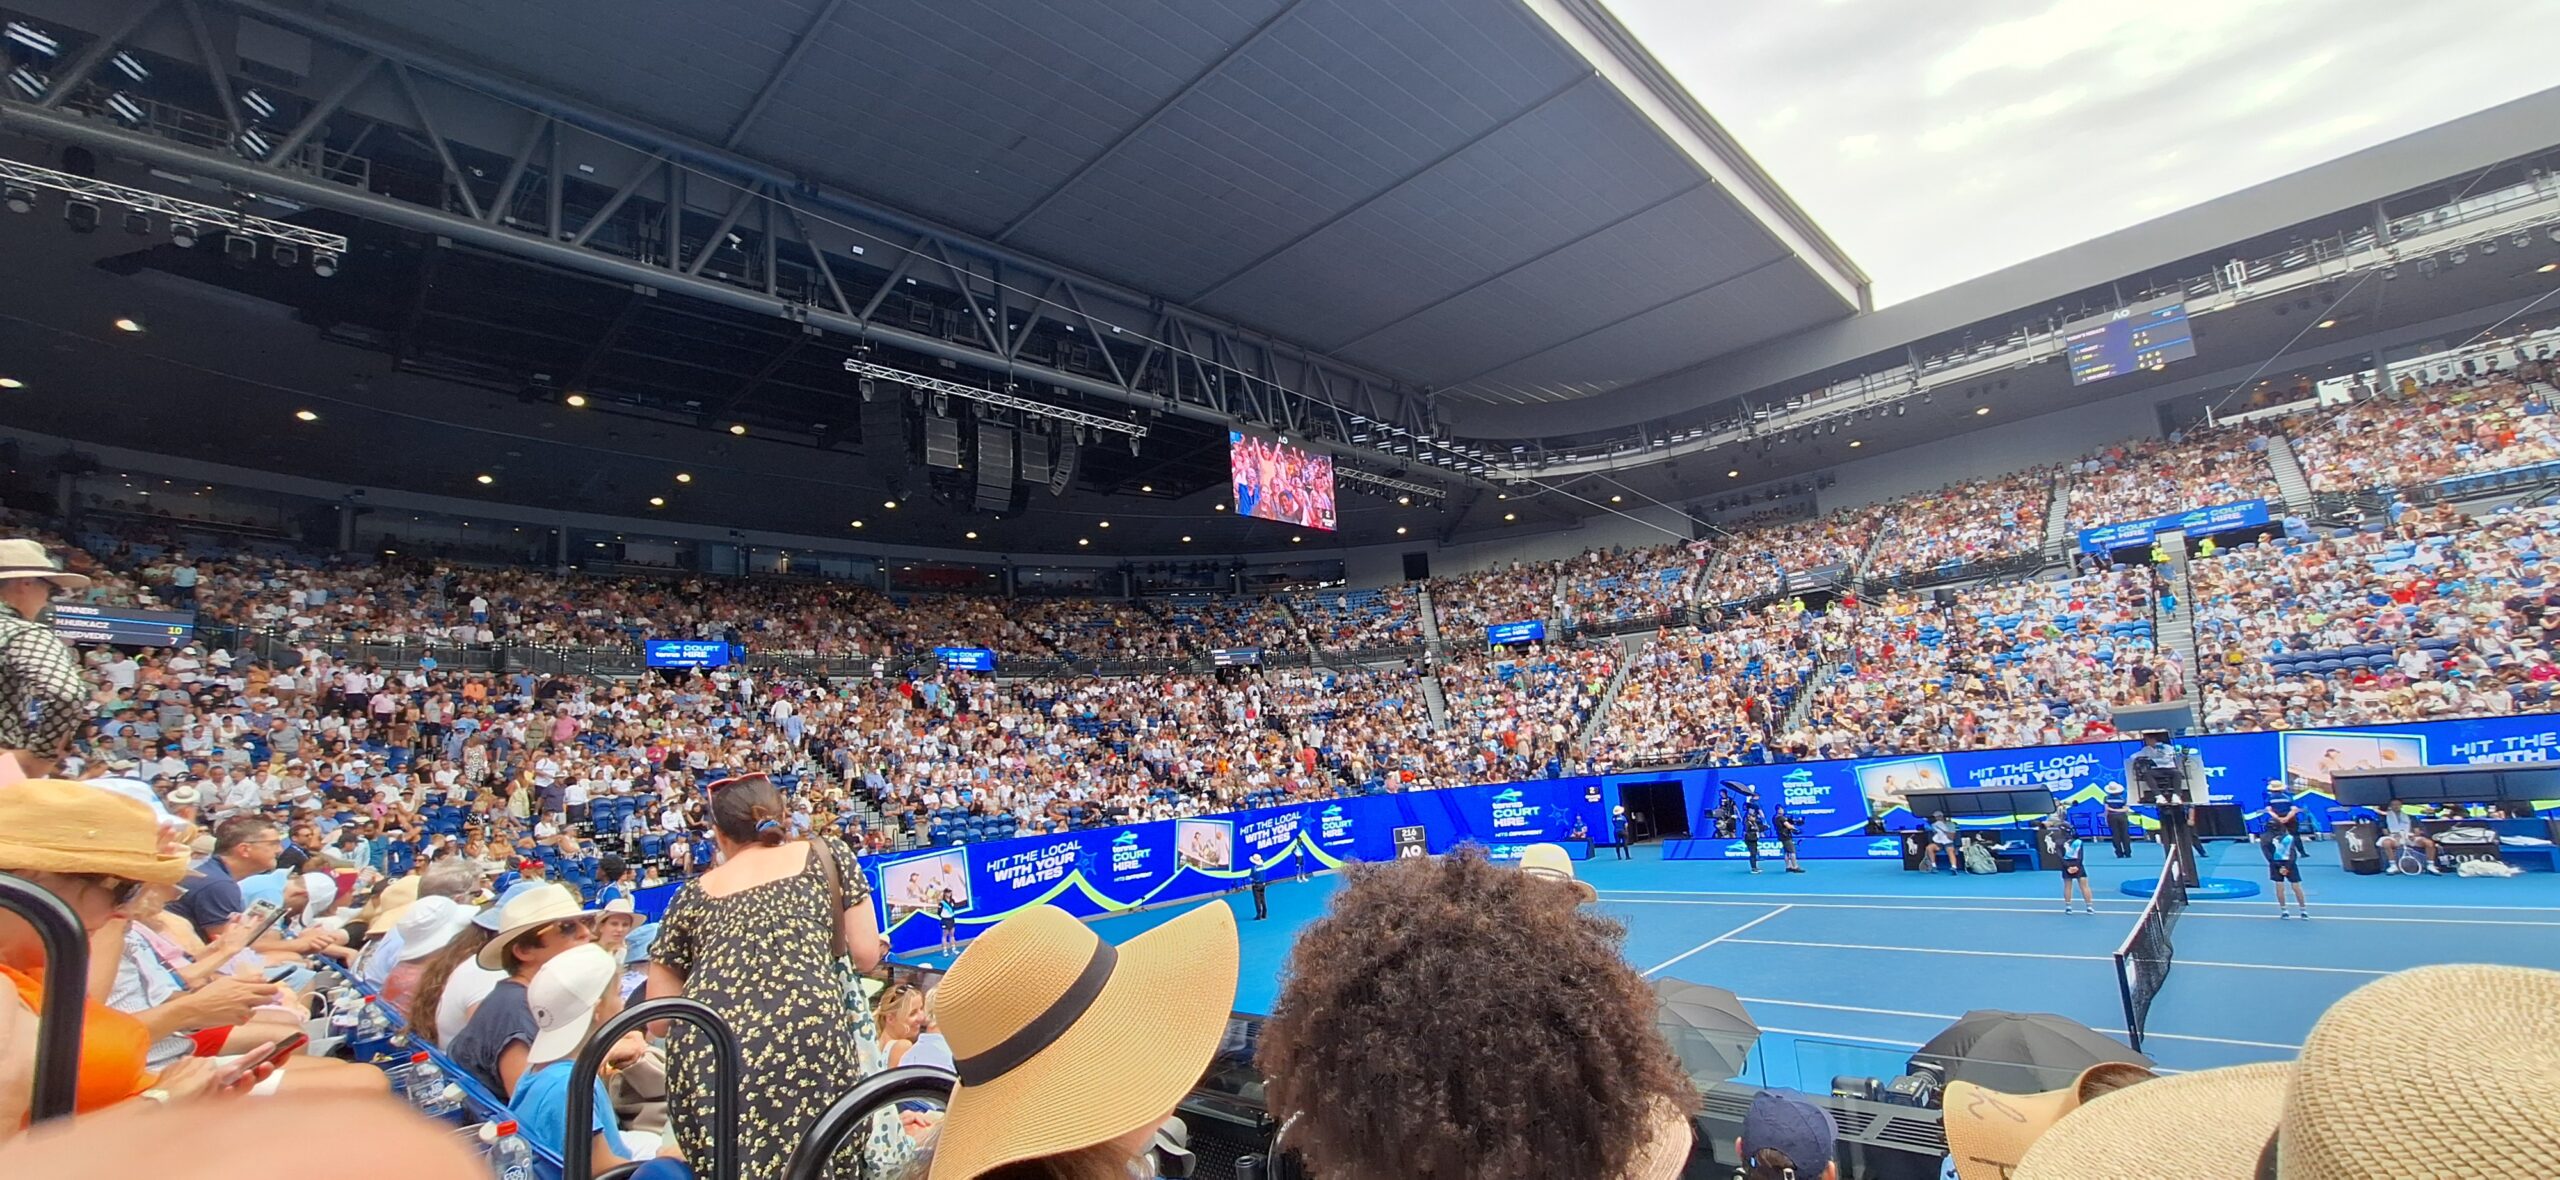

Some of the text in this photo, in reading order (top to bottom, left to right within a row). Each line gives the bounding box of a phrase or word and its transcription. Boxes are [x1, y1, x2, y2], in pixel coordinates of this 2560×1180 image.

[2112, 309, 2130, 321] AO
[2209, 503, 2255, 516] COURT
[2117, 520, 2158, 533] COURT
[168, 626, 183, 635] 10
[170, 637, 178, 645] 7
[683, 644, 720, 652] COURT
[2451, 731, 2558, 757] HIT THE
[2468, 747, 2547, 764] WITH
[1969, 752, 2100, 780] HIT THE LOCAL
[1980, 764, 2090, 787] WITH YOUR
[1782, 780, 1814, 789] tennis
[1784, 786, 1832, 797] COURT
[1492, 801, 1524, 810] tennis
[1785, 796, 1820, 805] HIRE.
[1492, 806, 1541, 818] COURT
[1240, 811, 1302, 836] HIT THE LOCAL
[1322, 819, 1354, 831] COURT
[1494, 817, 1529, 828] HIRE.
[1245, 820, 1298, 844] WITH YOUR
[1402, 828, 1417, 837] 216
[1257, 832, 1290, 850] MATES
[1757, 842, 1784, 850] COU
[986, 840, 1082, 872] HIT THE LOCAL
[1112, 848, 1152, 862] COURT
[1401, 844, 1422, 858] AO
[994, 851, 1075, 882] WITH YOUR
[1113, 860, 1142, 872] HIRE.
[1012, 866, 1064, 890] MATES
